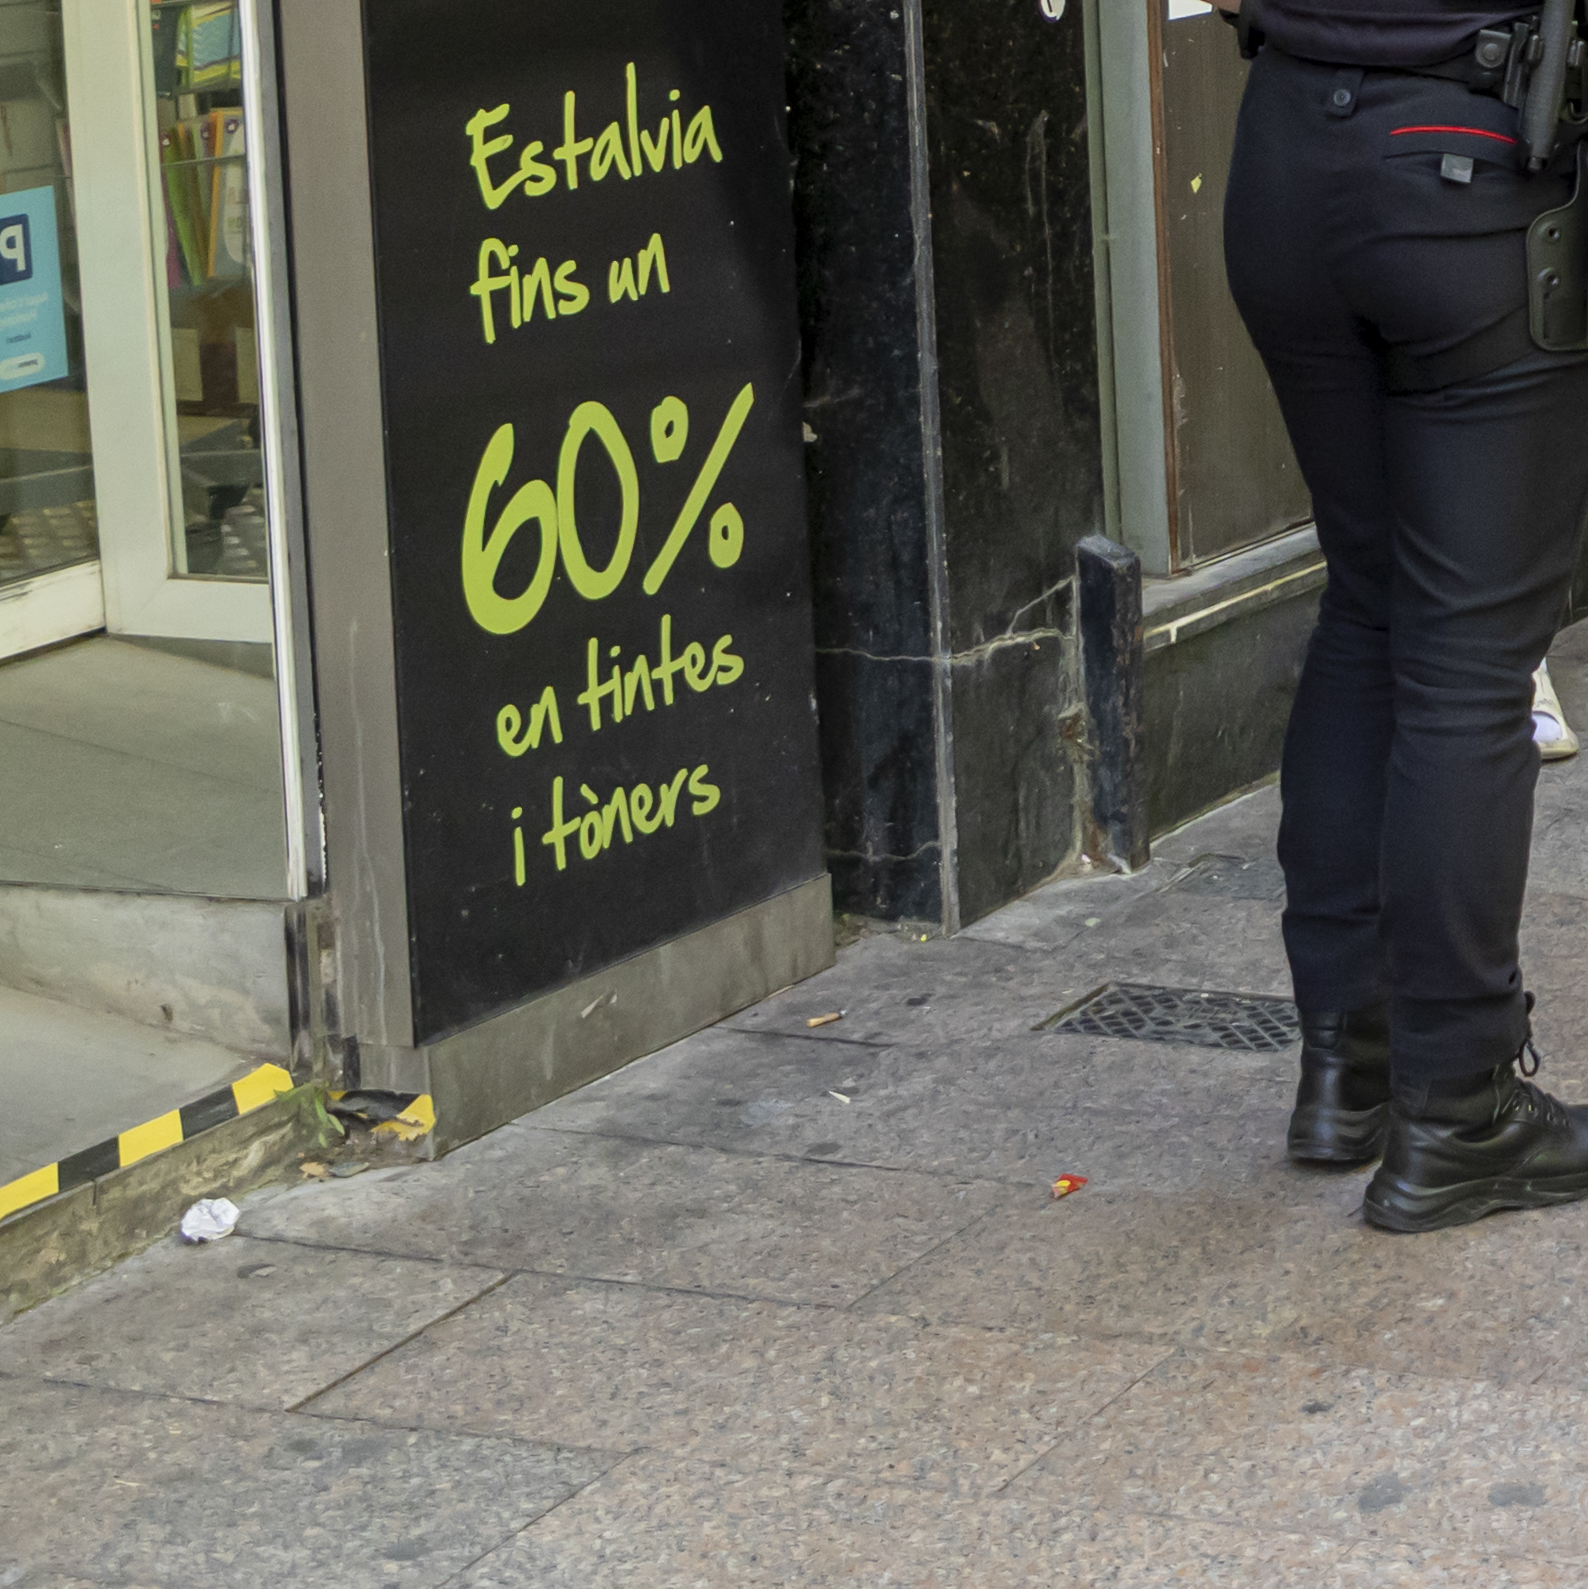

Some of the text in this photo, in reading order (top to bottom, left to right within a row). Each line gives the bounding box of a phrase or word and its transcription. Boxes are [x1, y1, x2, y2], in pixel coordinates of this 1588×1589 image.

[466, 62, 723, 209] Estalvia
[470, 233, 670, 344] fins un
[461, 383, 755, 635] 60%
[496, 614, 745, 757] en tintes
[513, 764, 721, 887] i tòners
